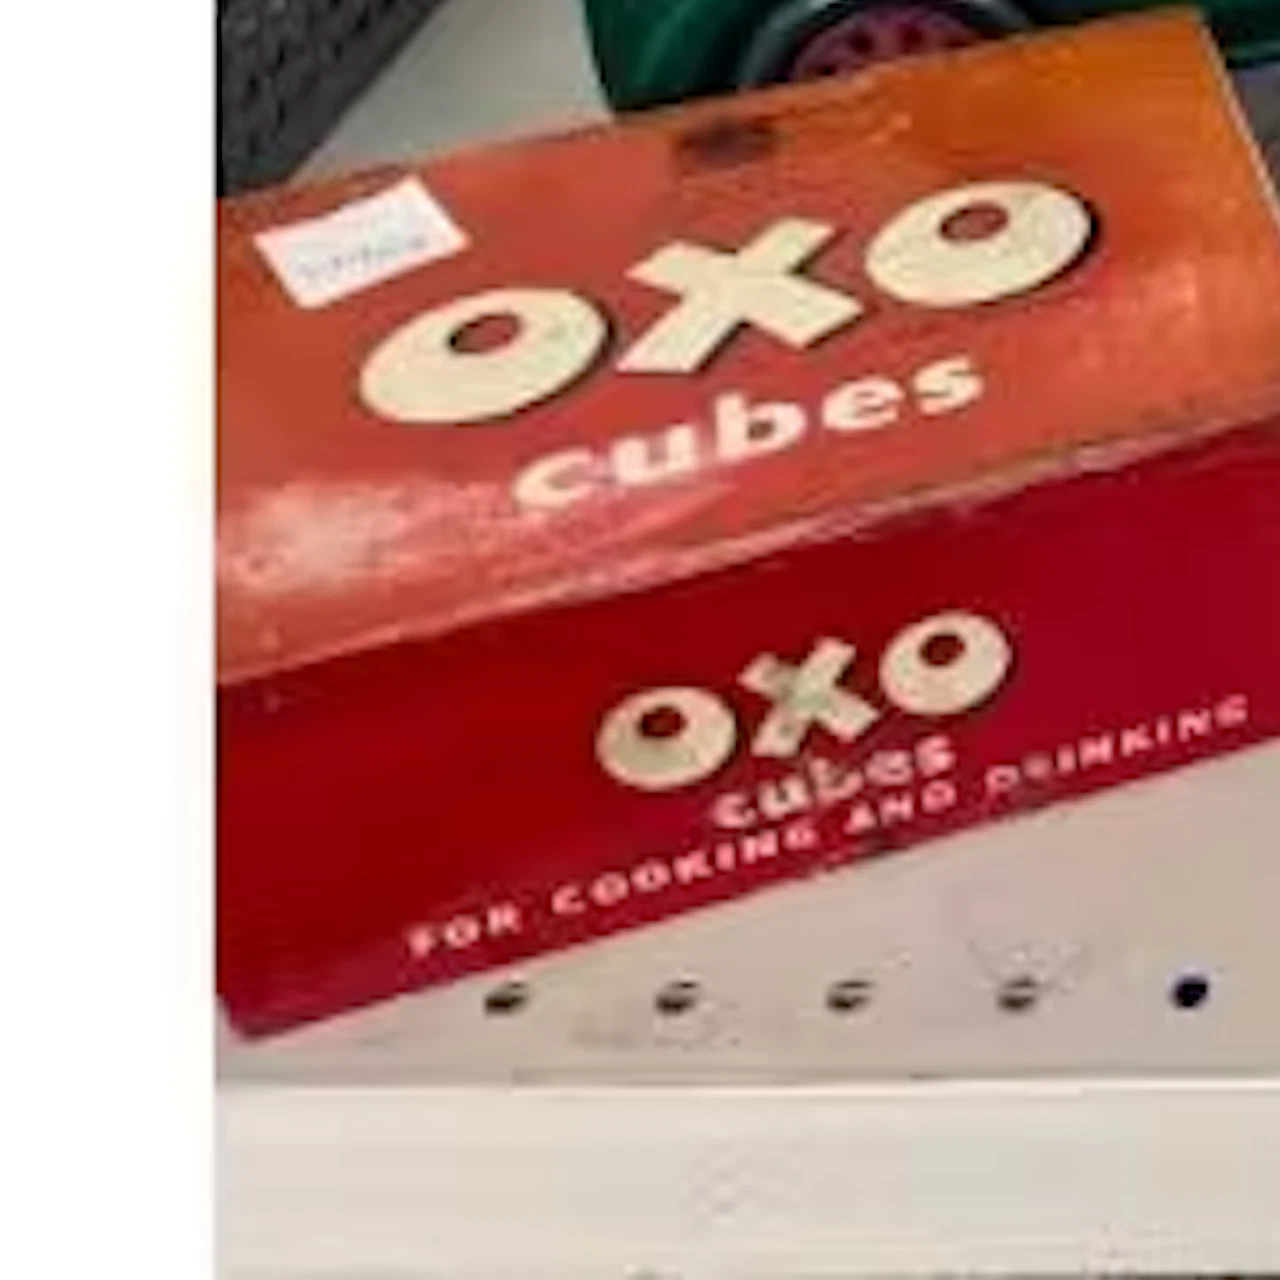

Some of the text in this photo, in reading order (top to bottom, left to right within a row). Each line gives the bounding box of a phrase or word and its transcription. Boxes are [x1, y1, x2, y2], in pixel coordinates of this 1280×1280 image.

[358, 181, 1098, 424] OXO
[510, 353, 985, 509] cubes
[596, 609, 1012, 792] OXO
[710, 734, 958, 831] cubes
[408, 903, 521, 959] FOR
[551, 821, 817, 917] COOKING
[844, 776, 959, 837] AND
